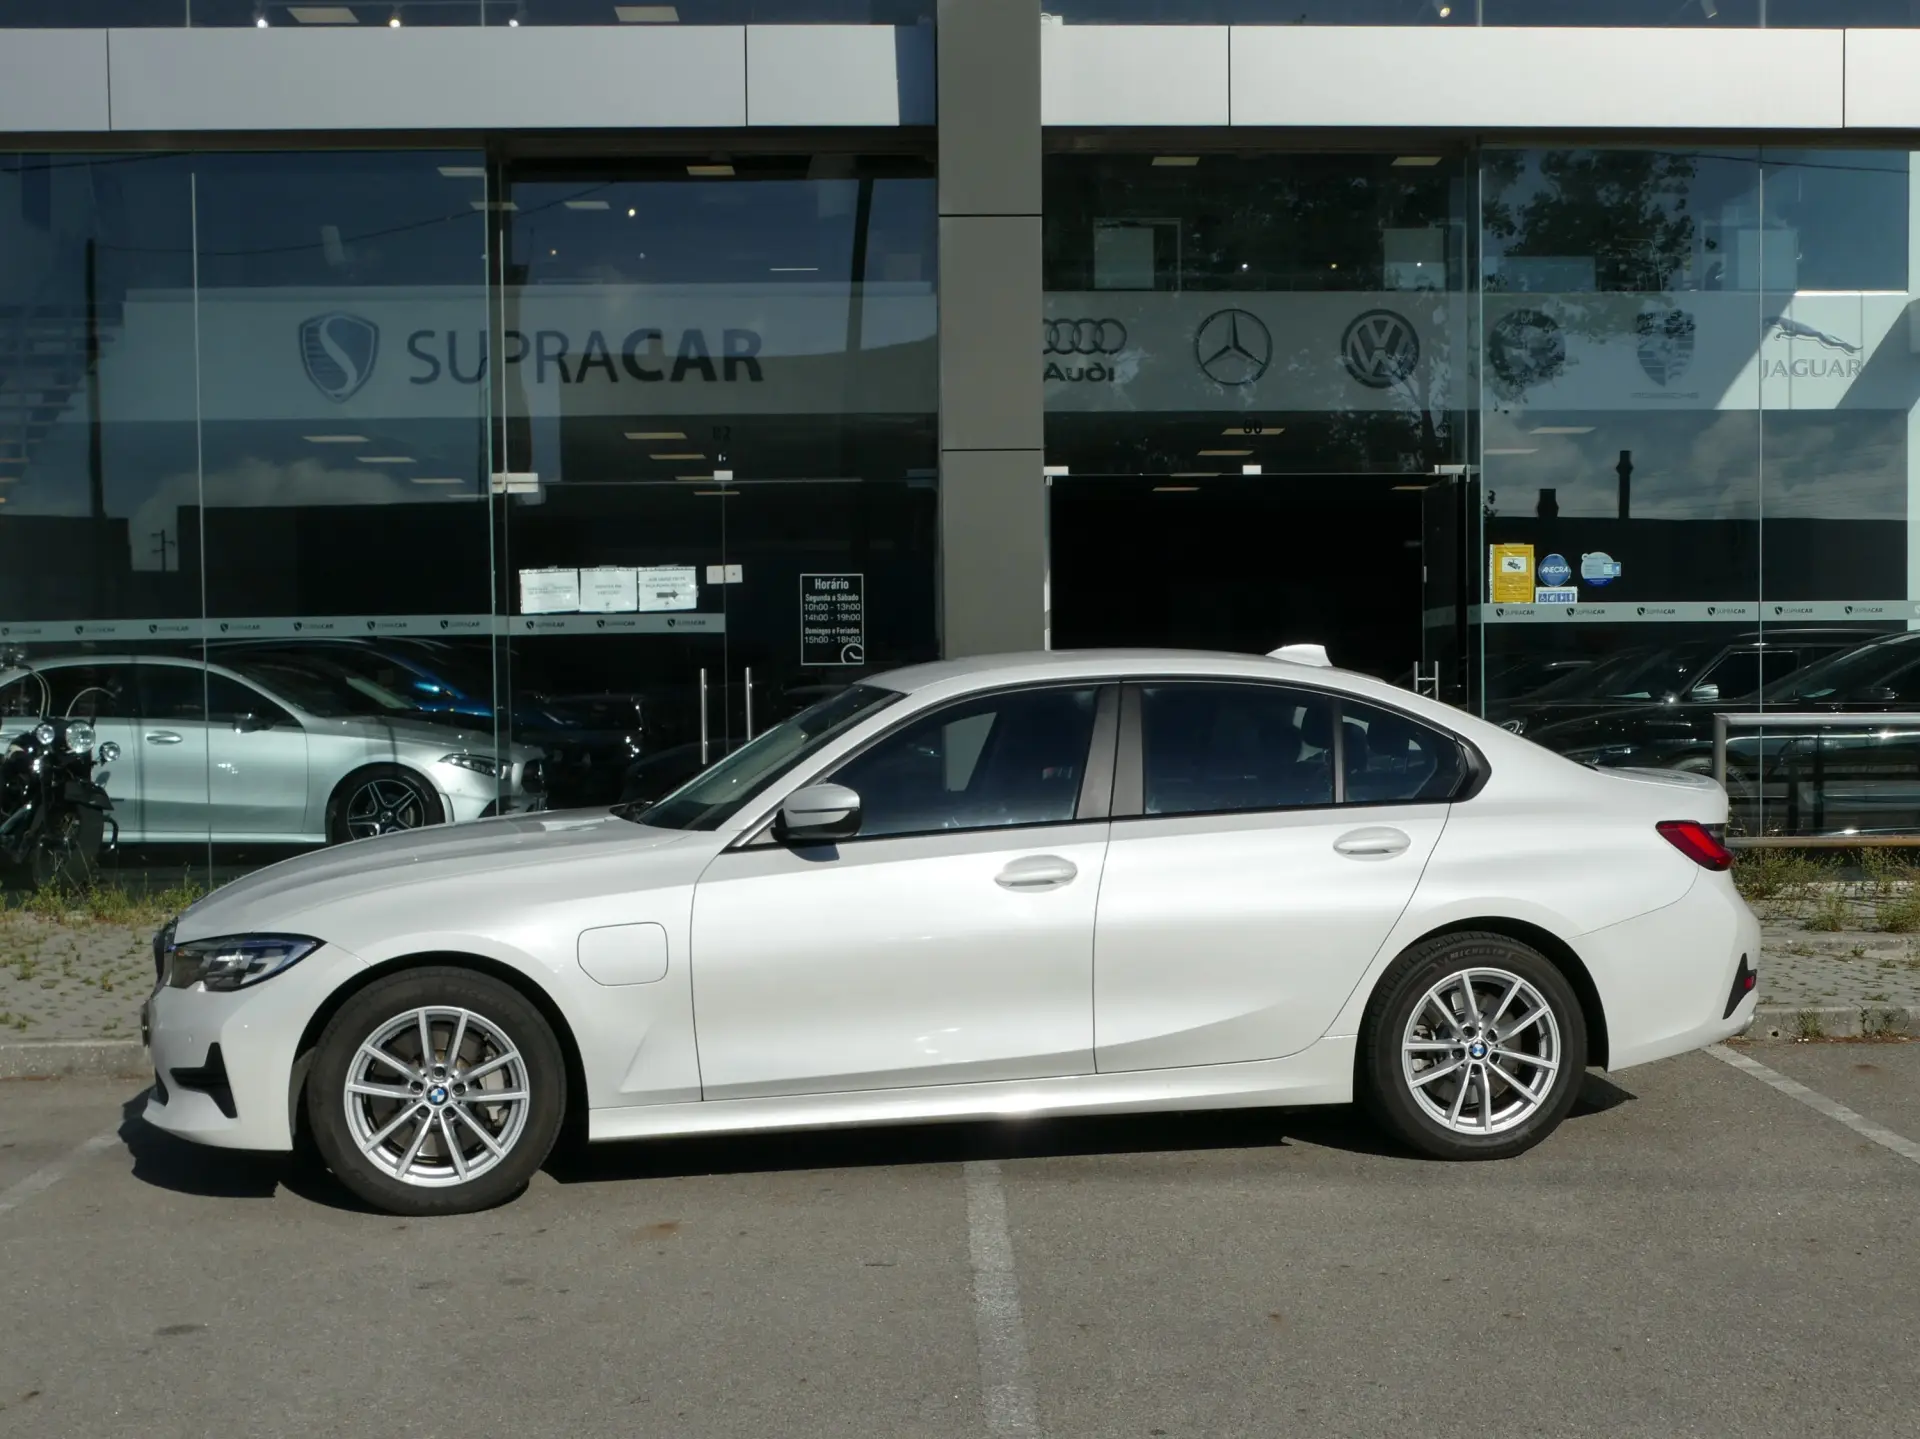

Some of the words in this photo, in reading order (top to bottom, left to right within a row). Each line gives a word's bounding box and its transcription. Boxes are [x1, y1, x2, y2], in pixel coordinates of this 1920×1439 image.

[406, 328, 764, 384] SUPRACAR
[1761, 358, 1863, 379] JAGUAR
[1541, 565, 1569, 574] ANECRA
[814, 578, 849, 590] Horário
[805, 593, 831, 603] Segunda
[837, 593, 859, 602] Sábado
[804, 603, 829, 611] 10h00
[836, 603, 861, 611] 13h00
[804, 613, 829, 621] 14h00
[837, 613, 861, 621] 19h00
[804, 627, 831, 636] Domingos
[804, 636, 829, 644] 15h00
[836, 636, 861, 644] 18h00
